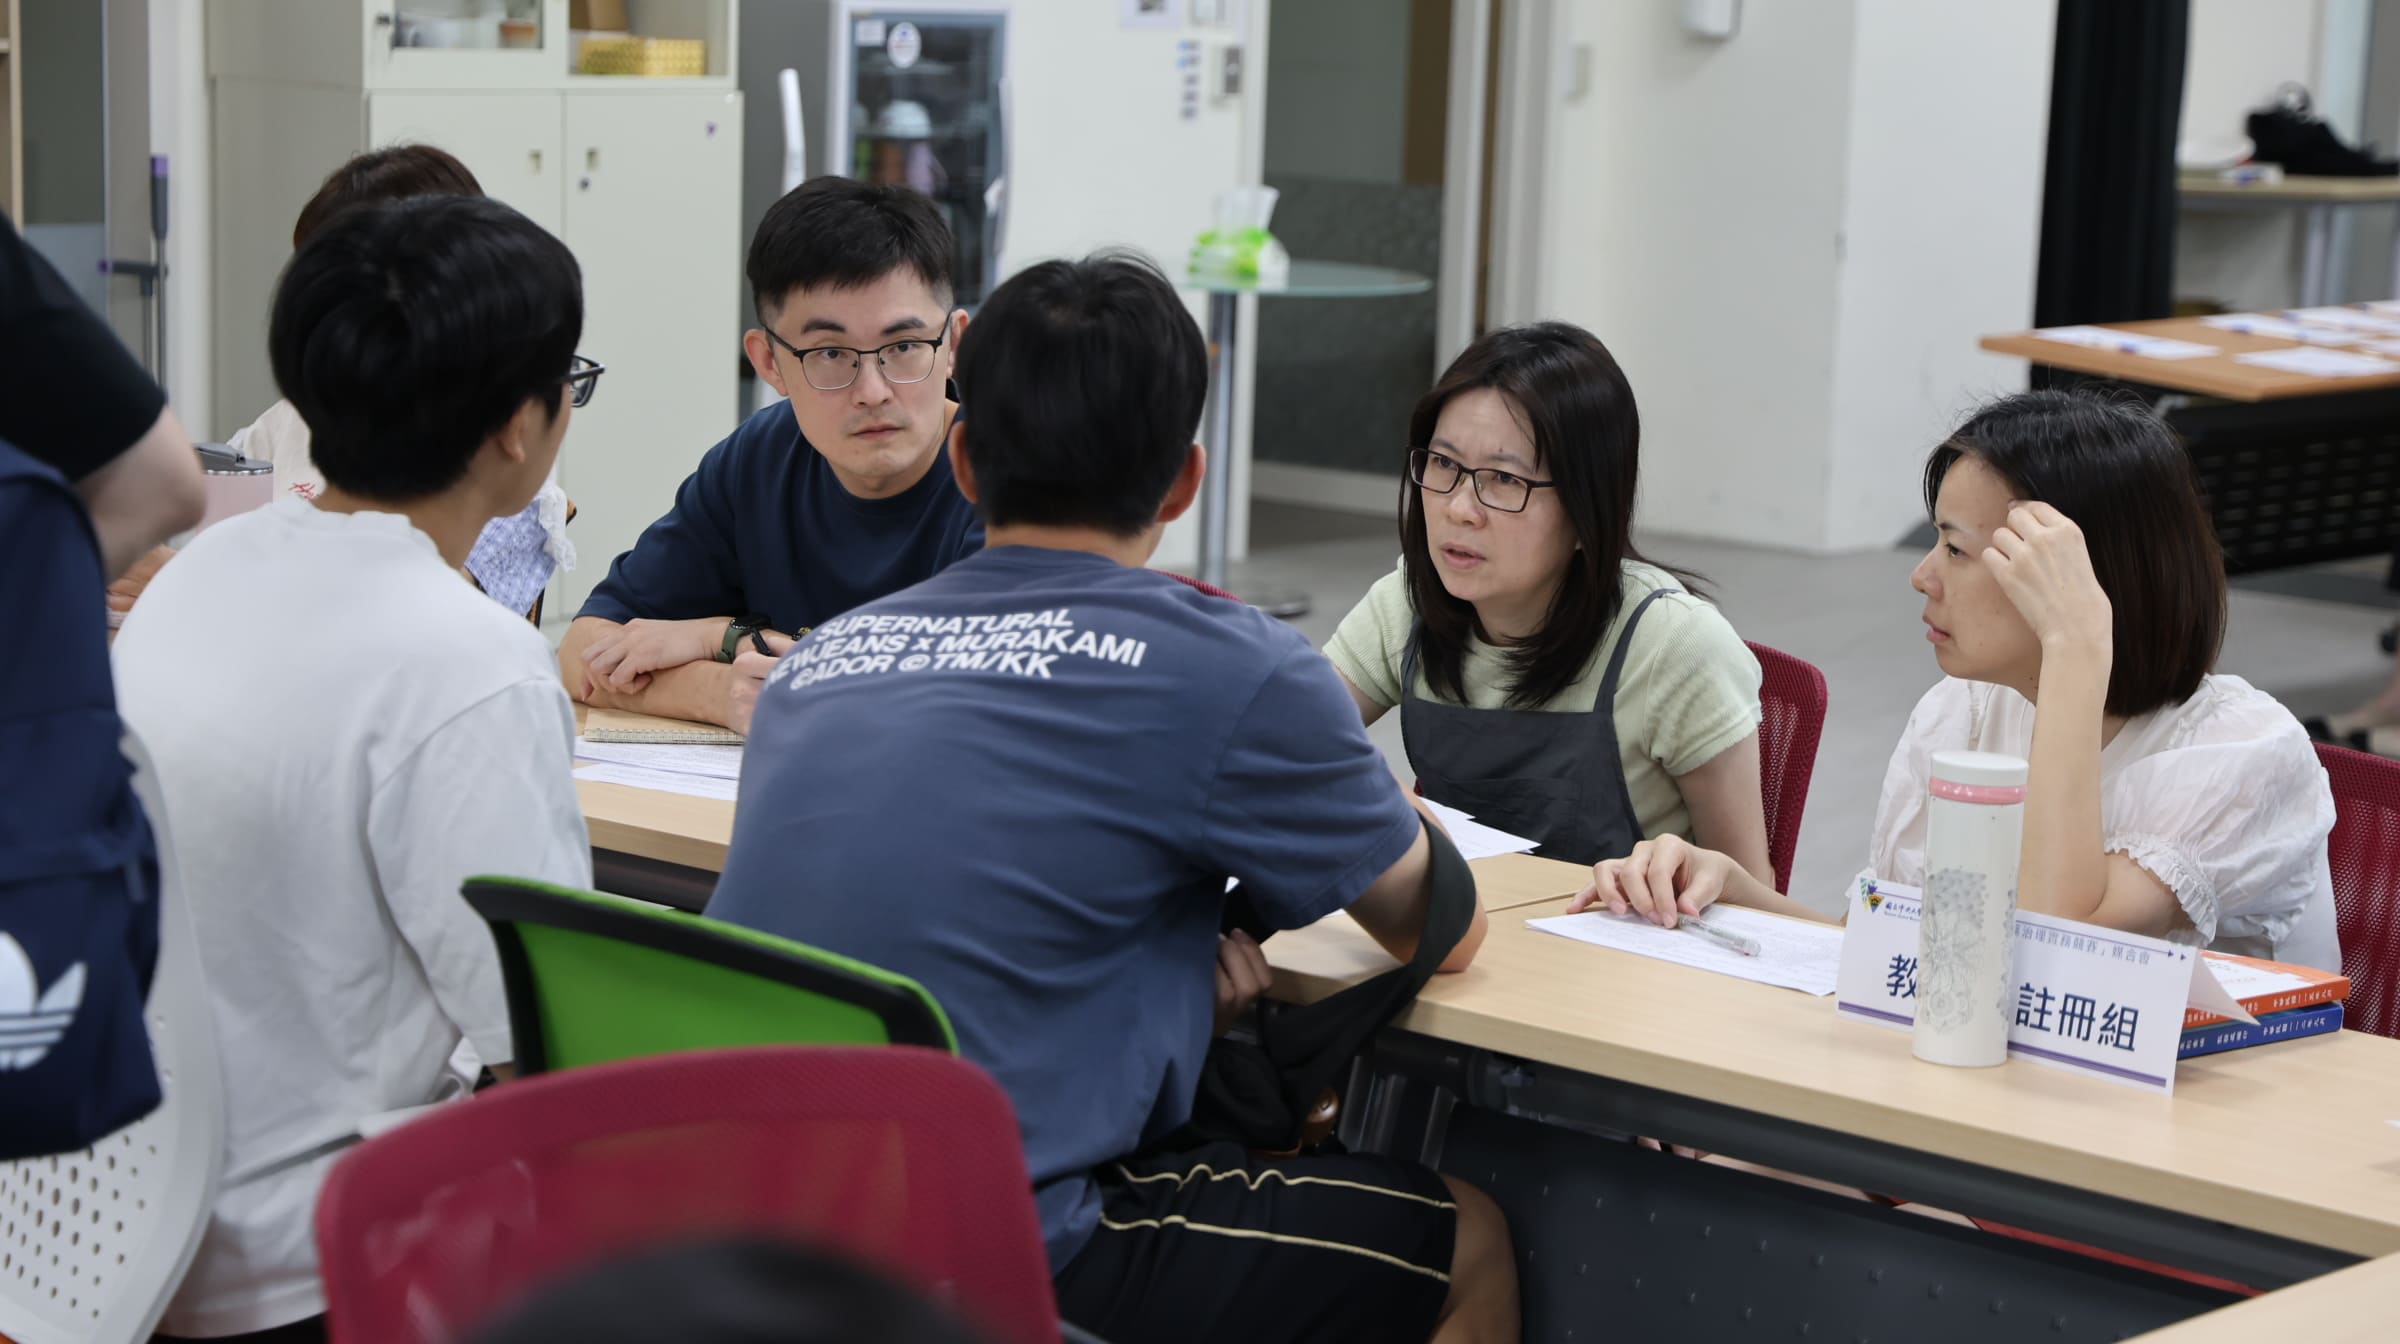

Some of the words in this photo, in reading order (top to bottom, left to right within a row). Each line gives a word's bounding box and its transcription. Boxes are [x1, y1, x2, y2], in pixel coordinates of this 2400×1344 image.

[815, 608, 1074, 642] SUPERNATURAL
[935, 628, 1148, 668] MURAKAMI
[2014, 981, 2140, 1053] 註冊組
